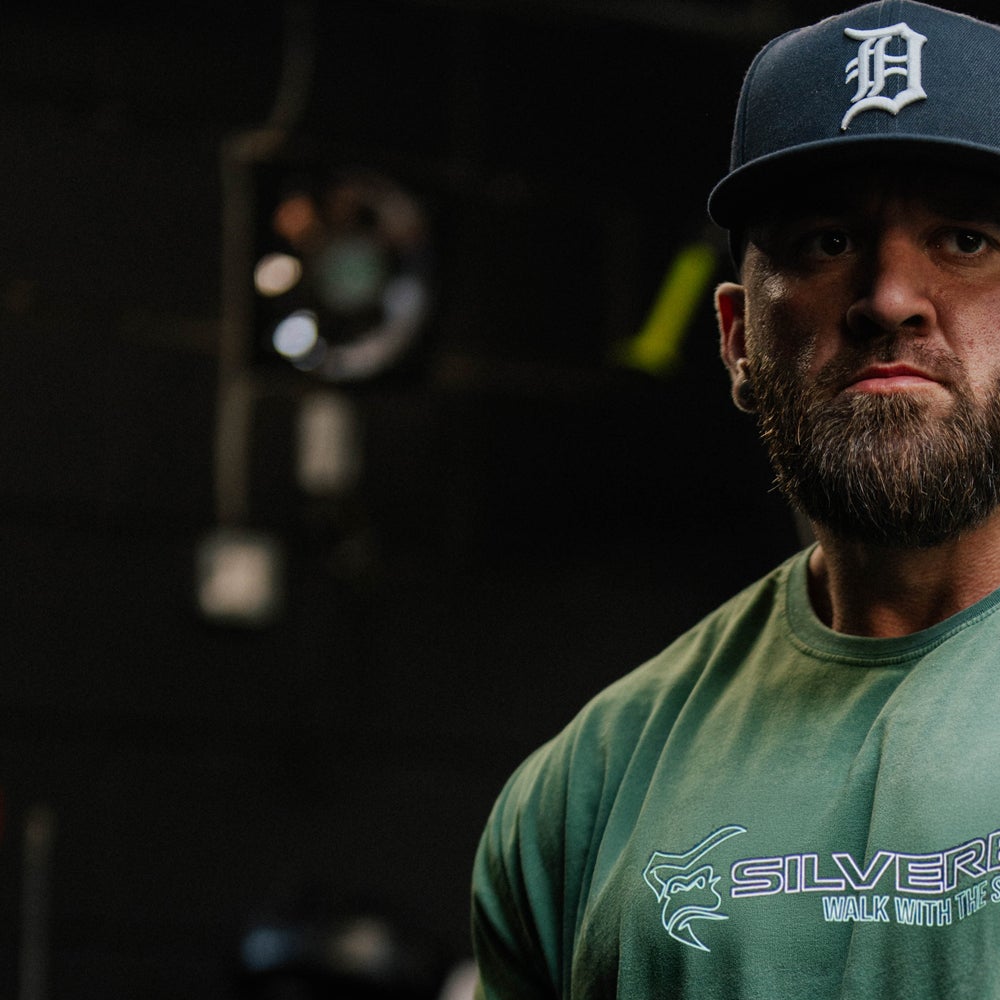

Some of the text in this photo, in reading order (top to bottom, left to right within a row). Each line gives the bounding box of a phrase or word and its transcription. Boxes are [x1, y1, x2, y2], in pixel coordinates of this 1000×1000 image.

[841, 22, 928, 131] D
[822, 895, 890, 922] WALK
[894, 896, 952, 926] WITH
[954, 880, 988, 920] THE
